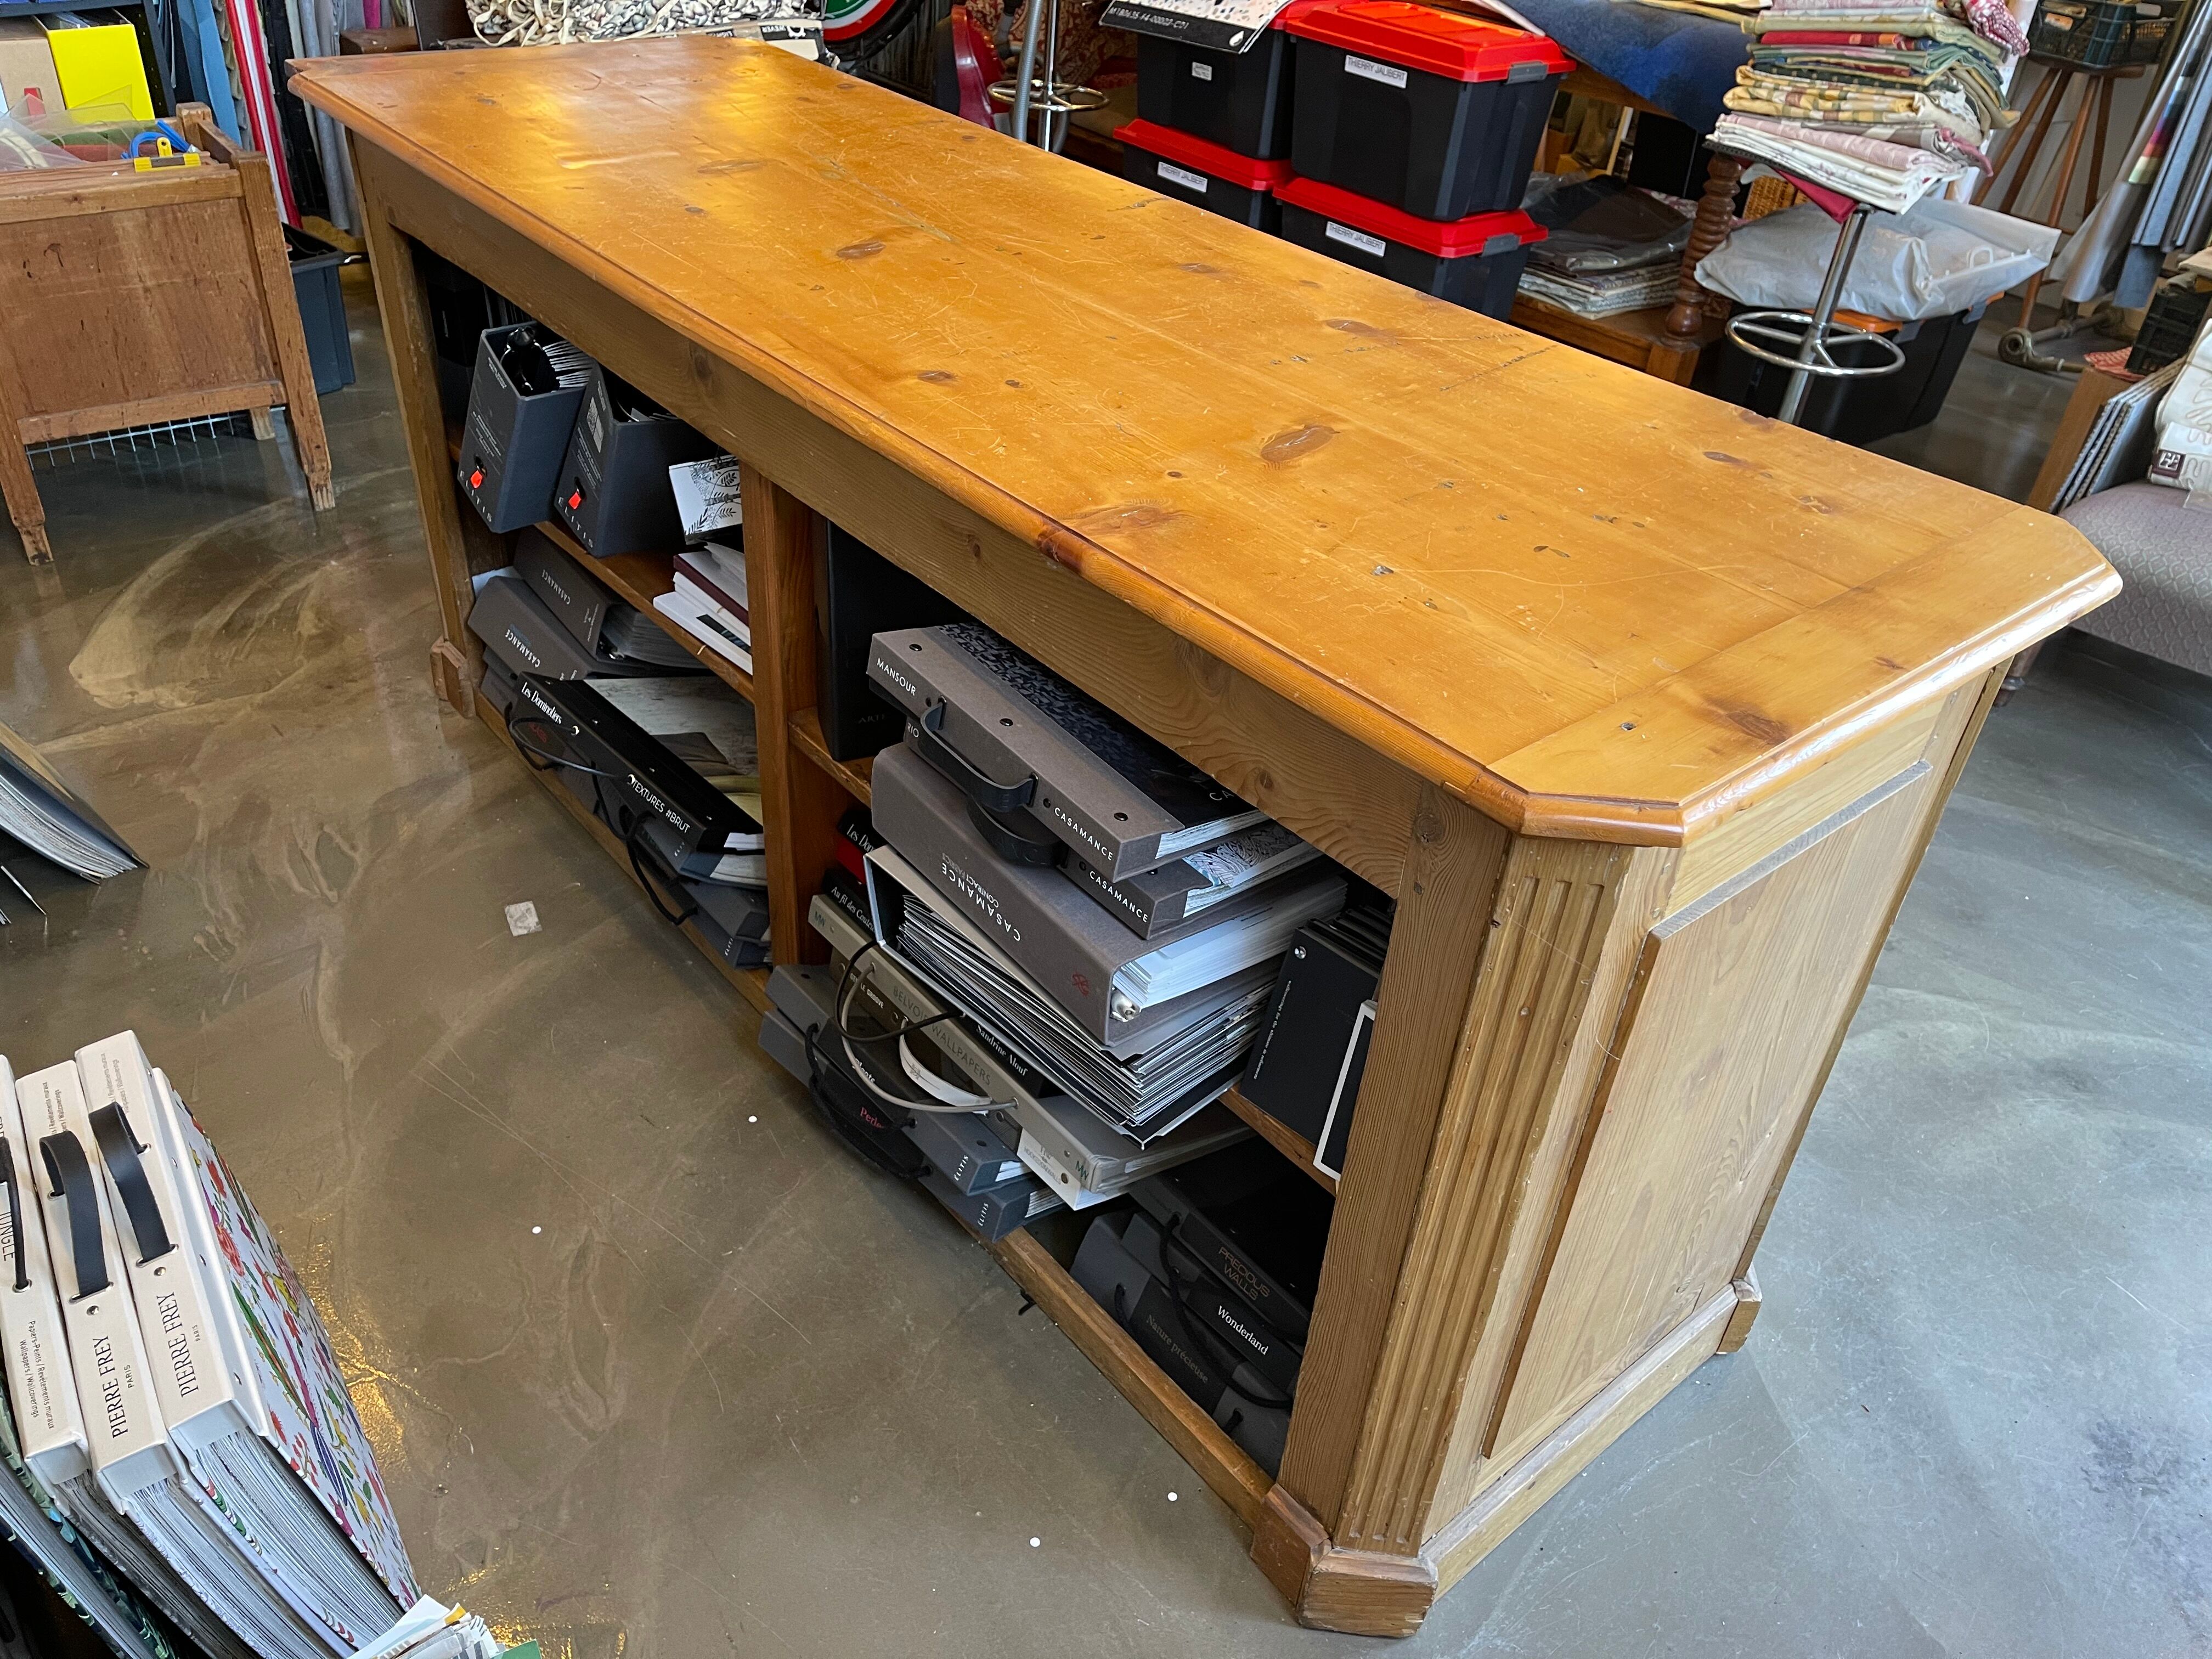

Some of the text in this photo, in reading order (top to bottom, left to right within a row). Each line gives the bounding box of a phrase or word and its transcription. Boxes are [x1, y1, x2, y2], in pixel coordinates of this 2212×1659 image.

[1348, 57, 1406, 81] THIERRY JALIBERT
[1329, 223, 1384, 249] THIERRY JALIBERT
[558, 496, 593, 548] ELITIS
[541, 569, 571, 605] CASAMANCE
[505, 629, 540, 668] CASAMANCE
[521, 681, 531, 698] Les
[877, 658, 916, 696] MANSOUR
[632, 780, 665, 812] TEXTURES
[665, 809, 690, 833] #BRUT
[847, 823, 859, 842] Les
[1054, 807, 1113, 861] CASAMANCE
[831, 887, 874, 932] Au fil des Couleu
[942, 862, 1020, 941] CASAMANCE
[966, 874, 999, 908] CONTRACT
[1090, 871, 1148, 923] CASAMANCE
[933, 1026, 991, 1086] WALLPAPERS
[976, 1024, 1007, 1057] Sandrine
[0, 1211, 14, 1261] JUNGLE
[1218, 1246, 1271, 1297] PRECIOUS
[1224, 1263, 1259, 1301] WALLS
[156, 1291, 200, 1398] PIERRE FREY
[192, 1324, 201, 1342] PARIS
[1146, 1314, 1209, 1383] Nature précieuse
[1218, 1305, 1269, 1355] Wonderland
[19, 1339, 31, 1373] Wallpapers
[26, 1376, 39, 1418] Wallcoverings
[28, 1320, 42, 1363] Papiers-Peints
[45, 1406, 54, 1430] muraux
[92, 1335, 128, 1438] PIERRE FREY
[123, 1364, 134, 1389] PARIS
